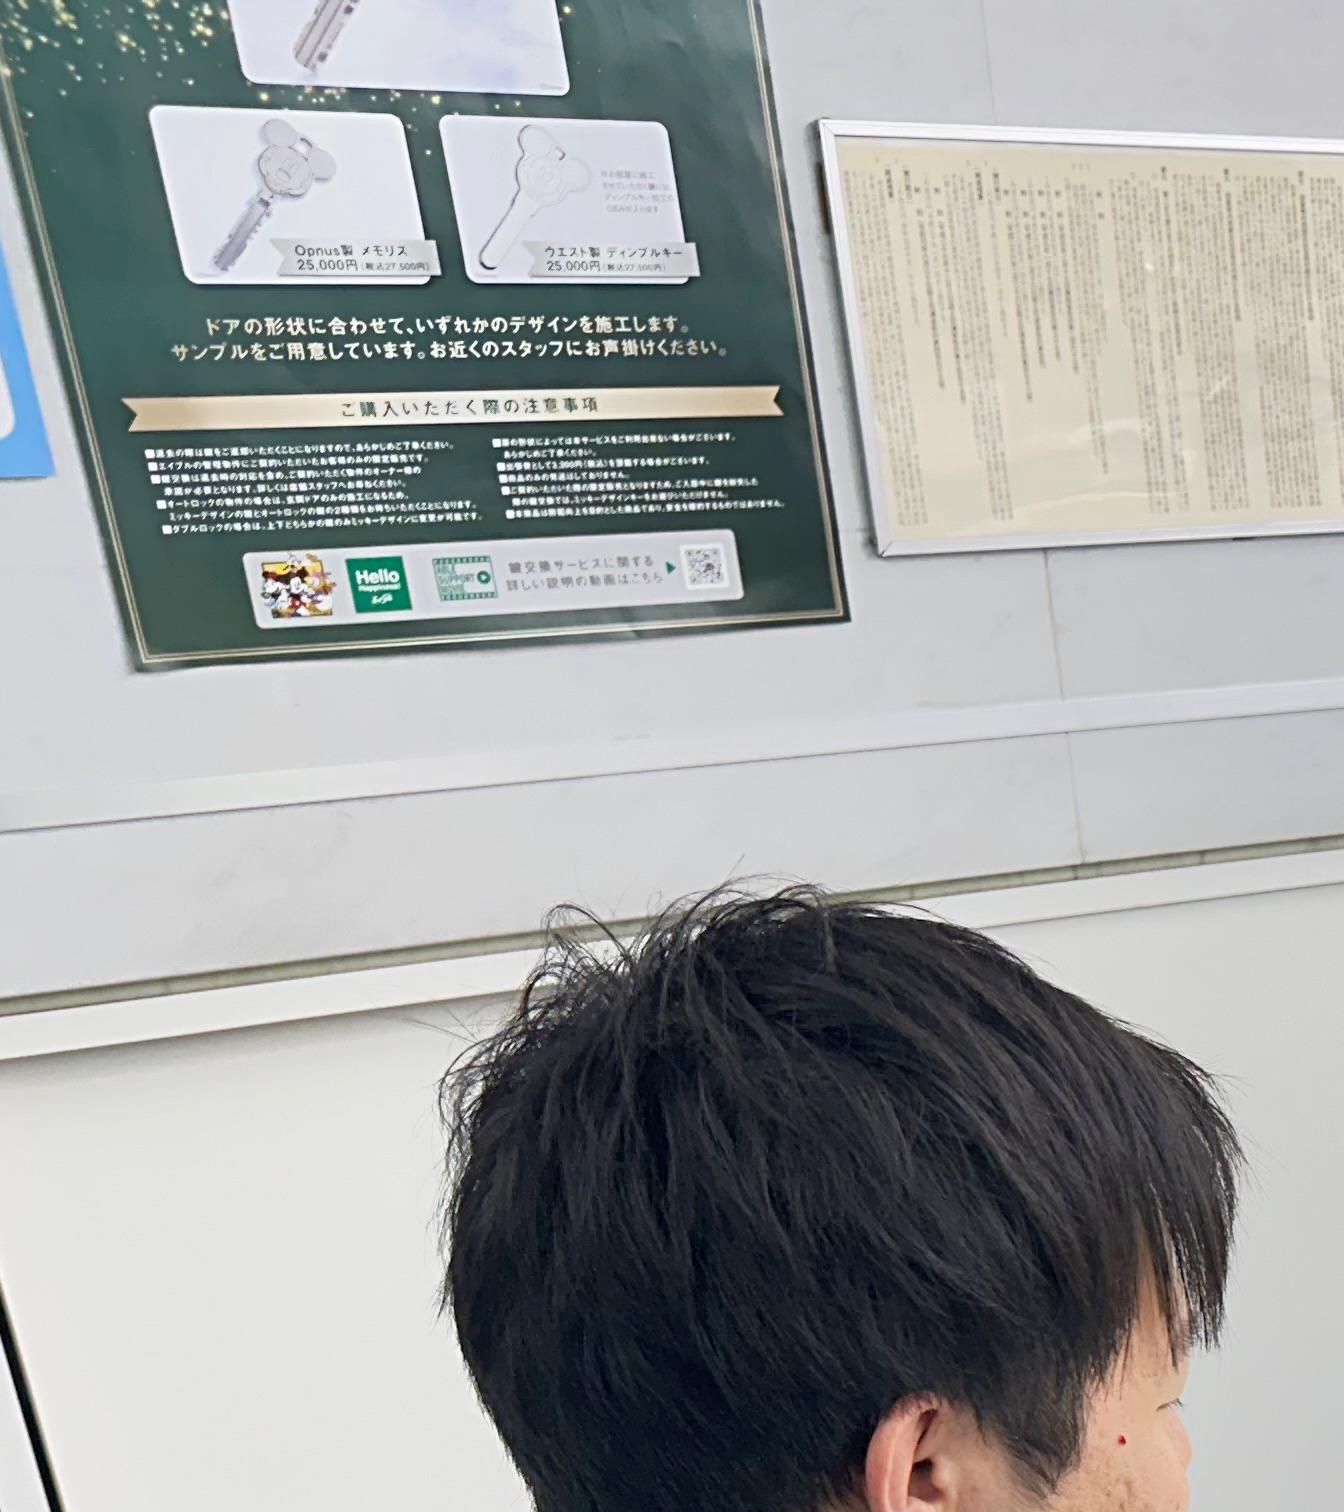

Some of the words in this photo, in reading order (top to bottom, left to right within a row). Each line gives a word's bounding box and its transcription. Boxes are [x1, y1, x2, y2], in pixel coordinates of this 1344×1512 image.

[361, 245, 408, 257] メモリス
[606, 247, 683, 259] ディンプルキー
[206, 315, 689, 337] ドアの形状に合わせて、いずれかのデザインを施工します。
[171, 338, 727, 362] サンプルをご用意しています。お近くのスタッフにお声掛けください。
[341, 397, 599, 418] ご購入いただく際の注意事項
[354, 568, 401, 585] Hello
